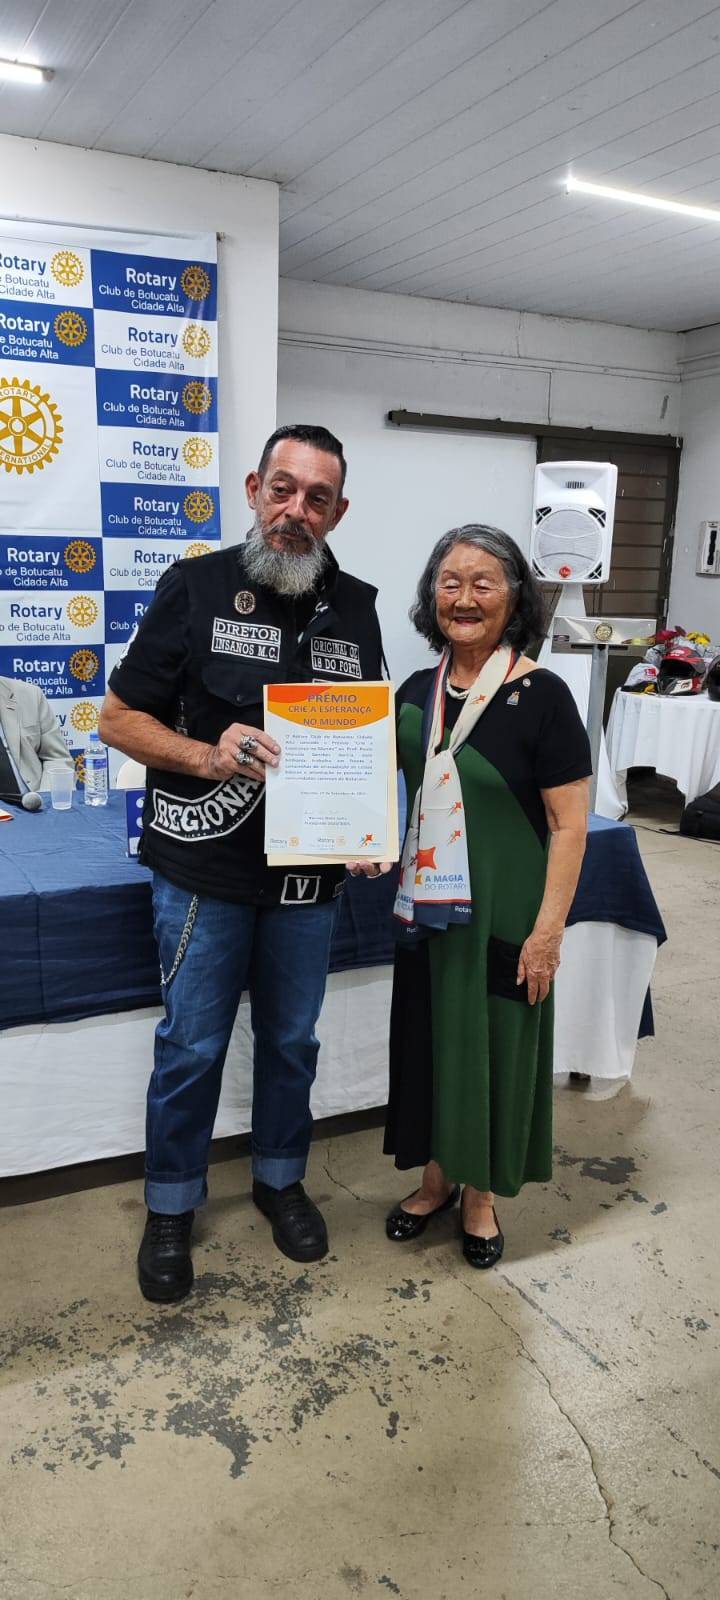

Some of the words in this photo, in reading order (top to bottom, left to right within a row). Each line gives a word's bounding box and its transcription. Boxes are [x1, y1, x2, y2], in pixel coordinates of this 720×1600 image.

[5, 273, 49, 288] Botucatu
[126, 267, 177, 290] Rotary
[0, 284, 33, 297] Cidade
[37, 288, 55, 300] Alta
[98, 285, 121, 296] Club
[124, 287, 135, 297] de
[137, 289, 180, 302] Botucatu
[131, 300, 165, 312] Cidade
[166, 302, 185, 313] Alta
[9, 334, 53, 348] Botucatu
[128, 327, 178, 347] Rotary
[2, 345, 38, 358] Cidade
[39, 348, 59, 360] Alta
[101, 345, 123, 356] Club
[125, 346, 137, 357] de
[140, 348, 181, 360] Botucatu
[133, 358, 167, 369] Cidade
[168, 360, 185, 371] Alta
[130, 384, 179, 406] Rotary
[103, 402, 125, 413] Club
[128, 403, 140, 414] de
[142, 404, 181, 417] Botucatu
[135, 414, 168, 426] Cidade
[169, 416, 185, 427] Alta
[133, 441, 179, 461] Rotary
[106, 459, 127, 469] Club
[130, 460, 142, 470] de
[144, 461, 181, 472] Botucatu
[137, 470, 167, 481] Cidade
[169, 472, 186, 482] Alta
[134, 496, 180, 515] Rotary
[108, 514, 129, 524] Club
[131, 515, 142, 525] de
[144, 516, 182, 527] Botucatu
[138, 525, 168, 536] Cidade
[169, 526, 187, 537] Alta
[7, 547, 60, 566] Rotary
[134, 550, 181, 564] Rotary
[5, 567, 17, 576] de
[20, 566, 63, 577] Botucatu
[109, 568, 129, 577] Club
[131, 568, 142, 577] de
[13, 577, 48, 587] Cidade
[50, 577, 69, 587] Alta
[10, 603, 62, 621] Rotary
[8, 623, 20, 632] de
[23, 622, 65, 632] Botucatu
[110, 621, 130, 630] Club
[216, 621, 279, 642] DIRETOR
[16, 632, 50, 642] Cidade
[53, 632, 71, 641] Alta
[214, 637, 255, 656] INSANOS
[258, 646, 278, 659] M.C.
[313, 640, 348, 656] ORIGINAL
[13, 658, 66, 675] Rotary
[324, 659, 337, 671] DO
[339, 660, 360, 676] FORTE
[25, 677, 68, 686] Botucatu
[55, 686, 73, 695] Alta
[308, 693, 357, 703] PRÊMIO
[288, 705, 308, 713] CRIE
[310, 705, 317, 713] A
[319, 705, 372, 715] ESPERANÇA
[303, 718, 317, 726] NO
[320, 718, 357, 726] MUNDO
[434, 874, 464, 883] MAGIA
[296, 879, 310, 899] V
